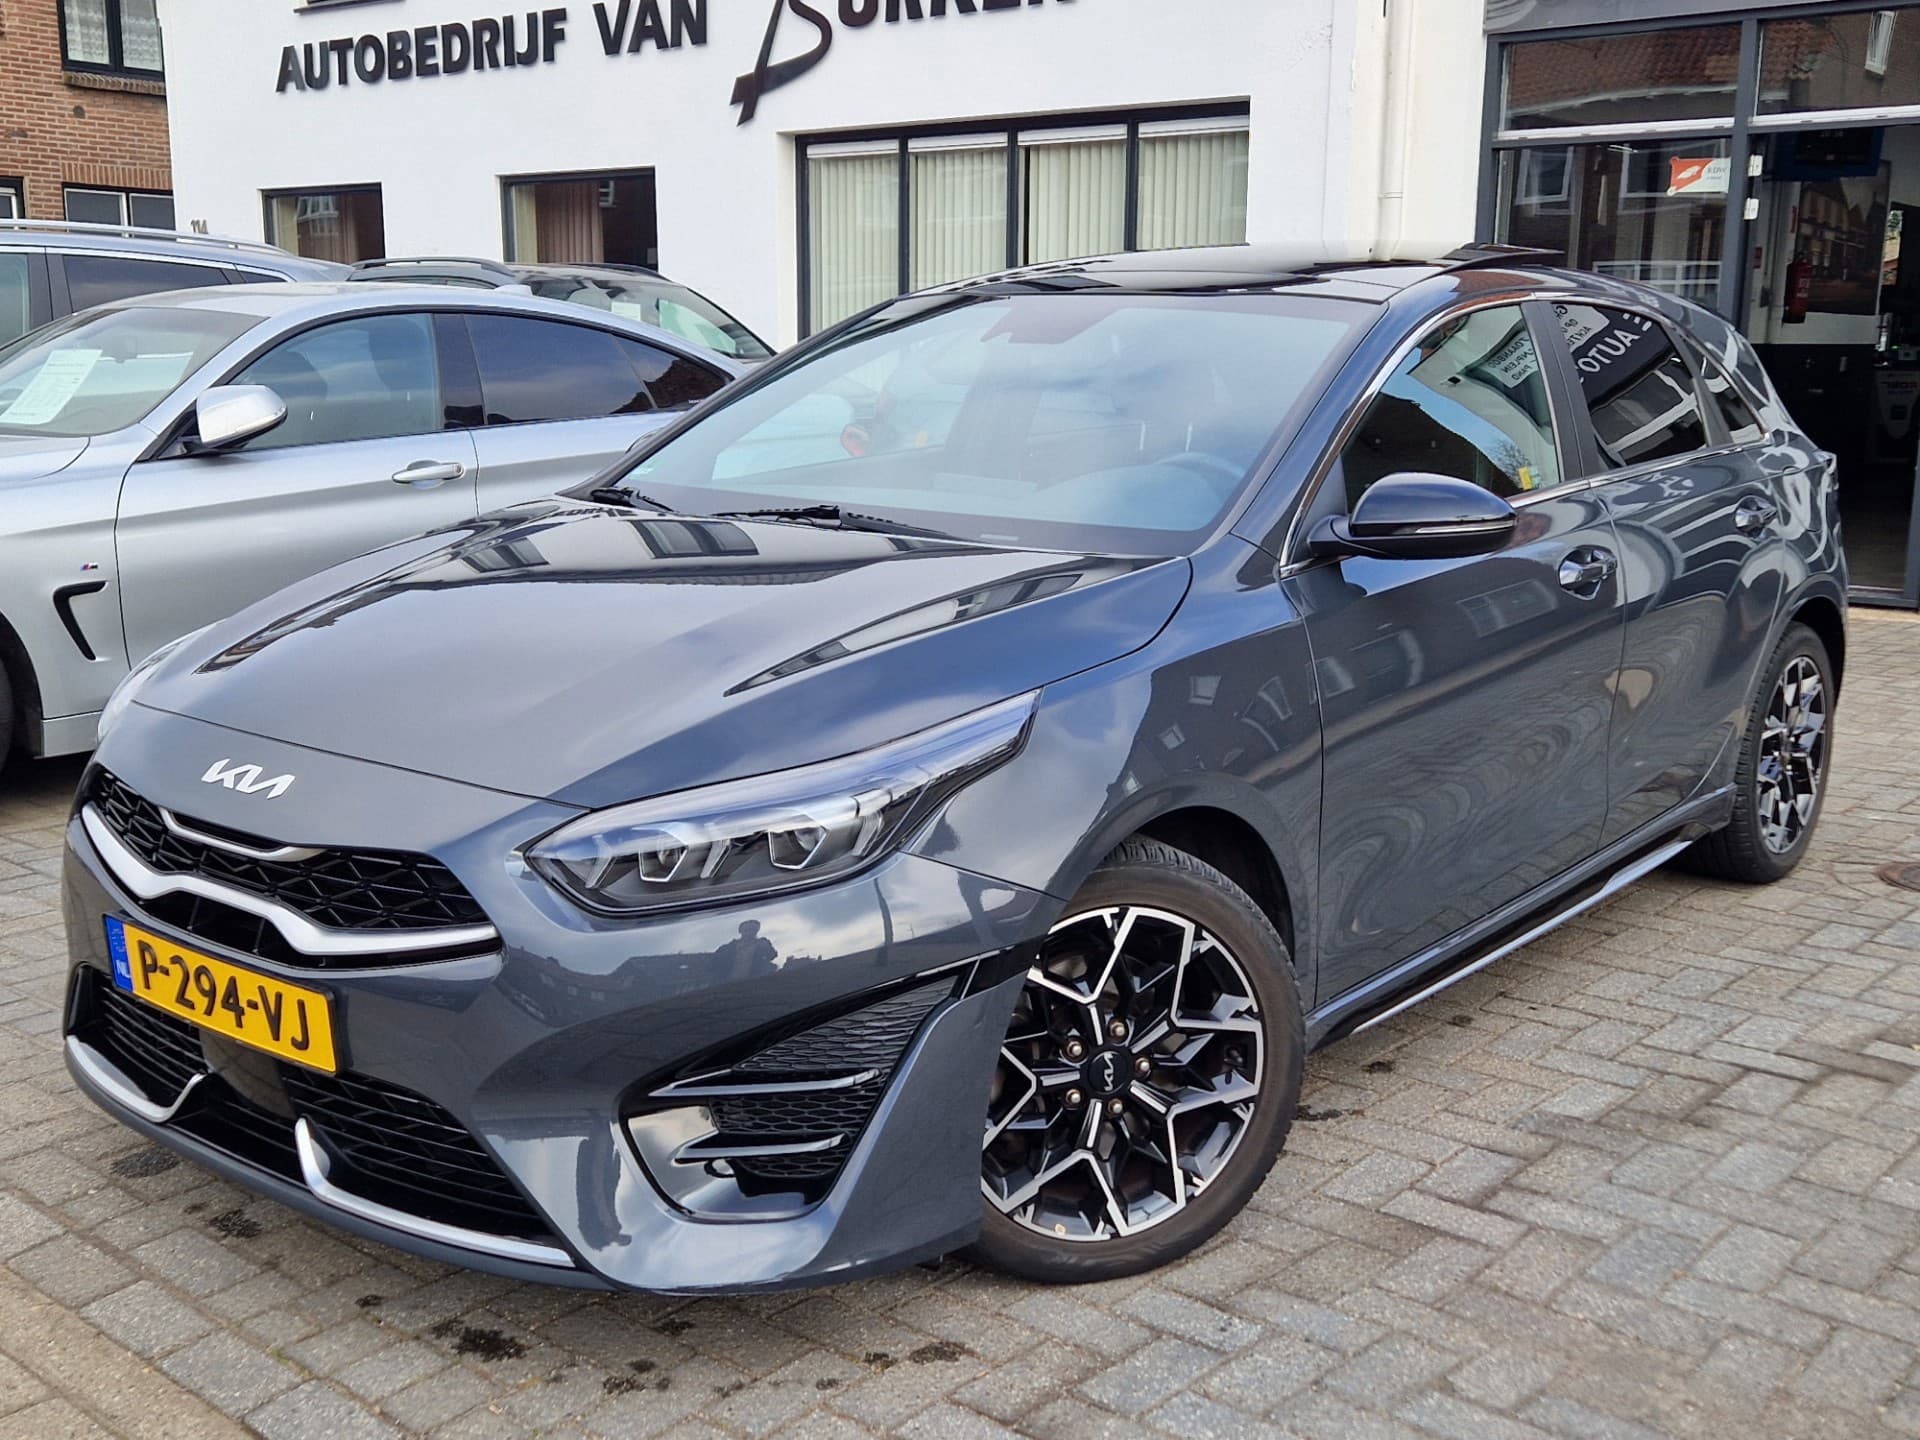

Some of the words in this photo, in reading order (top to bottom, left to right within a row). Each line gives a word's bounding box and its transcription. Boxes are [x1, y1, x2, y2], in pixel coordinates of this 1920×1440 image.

[276, 8, 567, 93] AUTOBEDRIJF
[592, 0, 708, 56] VAN
[137, 938, 310, 1051] P-294-VJ
